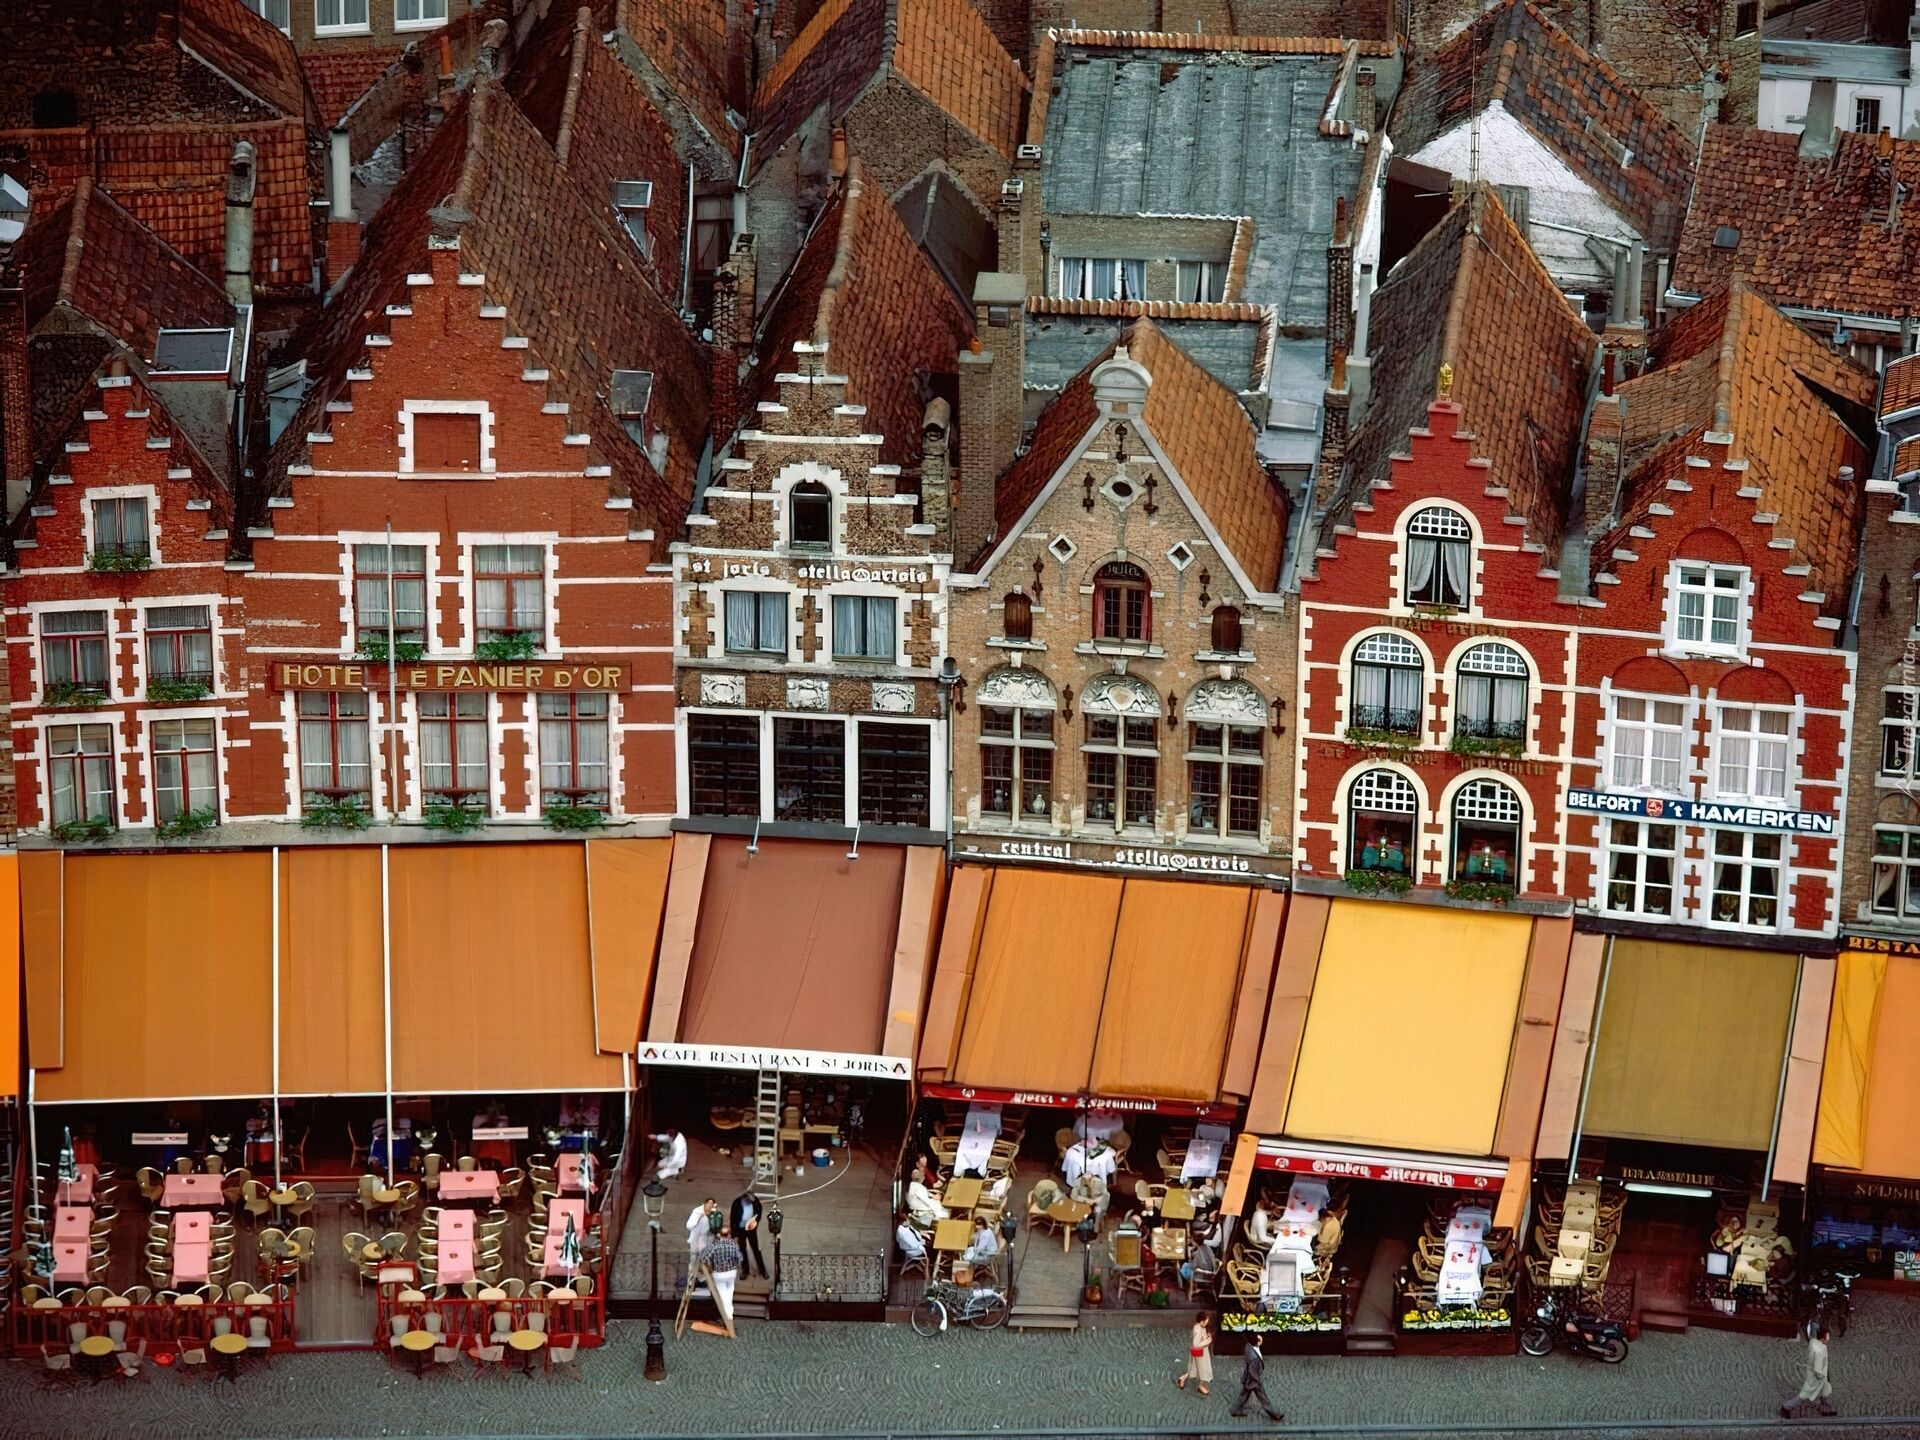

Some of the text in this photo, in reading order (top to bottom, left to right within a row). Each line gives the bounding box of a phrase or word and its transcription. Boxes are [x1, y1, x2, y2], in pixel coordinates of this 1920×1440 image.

[437, 664, 544, 688] PANIER
[553, 666, 623, 689] D'OR
[1568, 791, 1642, 813] BELFORT
[1691, 803, 1834, 832] HAMERKEN
[1000, 841, 1072, 859] central
[710, 1050, 810, 1068] RESTAURANT
[843, 1059, 889, 1073] JORIS
